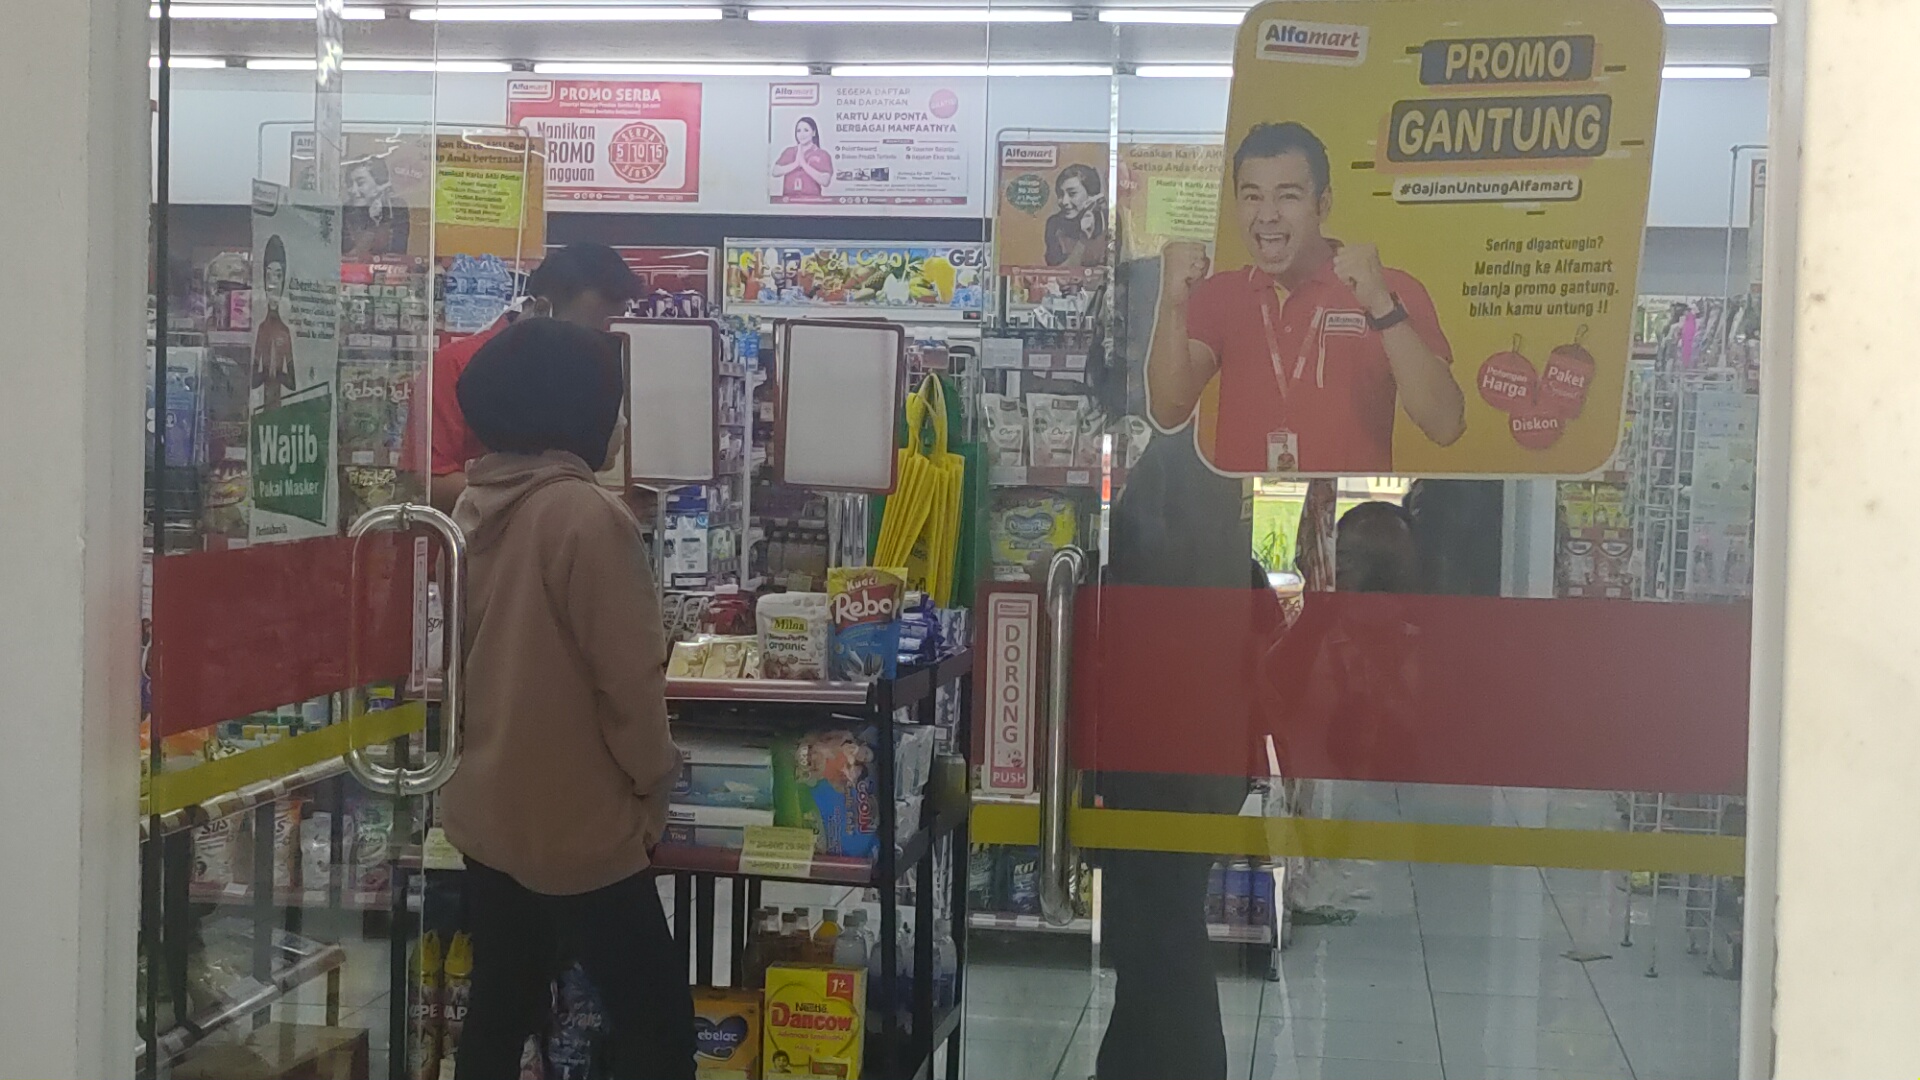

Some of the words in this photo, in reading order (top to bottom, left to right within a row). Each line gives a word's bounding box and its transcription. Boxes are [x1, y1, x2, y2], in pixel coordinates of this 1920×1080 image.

[1265, 23, 1361, 48] Alfamart
[1445, 40, 1572, 80] PROMO
[559, 87, 613, 101] PROMO
[615, 88, 662, 102] SERBA
[836, 87, 872, 96] SEGERA
[874, 88, 912, 96] DAFTAR
[836, 98, 857, 106] DAN
[859, 98, 909, 107] DAPATKAN
[836, 112, 870, 121] KARTU
[871, 112, 892, 121] AKU
[894, 113, 929, 121] PONTA
[536, 121, 596, 140] Nantikan
[620, 127, 656, 142] SERBA
[836, 124, 886, 133] BERBAGAI
[888, 124, 957, 133] MANFAATNYA
[1399, 105, 1601, 155] GANTUNG
[548, 141, 595, 165] ROMO
[616, 145, 624, 158] 5
[633, 145, 645, 158] 10
[650, 145, 663, 158] 15
[1005, 147, 1053, 158] Alfamart
[621, 164, 655, 179] SERBA
[1400, 178, 1575, 197] #GajianUntungAlfamart
[1486, 238, 1523, 253] Sering
[1526, 236, 1604, 253] digantungin?
[1474, 261, 1531, 277] Mending
[1535, 259, 1551, 275] ke
[1555, 259, 1613, 274] Alfamart
[1462, 281, 1511, 299] belanja
[1514, 283, 1556, 298] promo
[1470, 302, 1502, 317] bikin
[1506, 301, 1543, 317] kamu
[1547, 302, 1594, 317] untung
[1548, 366, 1586, 388] Paket
[1482, 375, 1527, 398] Harga
[1512, 417, 1559, 432] Diskon
[258, 424, 318, 474] Wajib
[259, 480, 283, 498] Pakai
[284, 479, 319, 497] Masker
[833, 589, 893, 624] Rebo
[774, 618, 805, 631] Milna
[769, 641, 807, 652] organic
[1002, 624, 1021, 744] DORONG
[993, 771, 1026, 784] PUSH
[831, 977, 848, 994] 1+
[771, 1002, 853, 1031] Dancow
